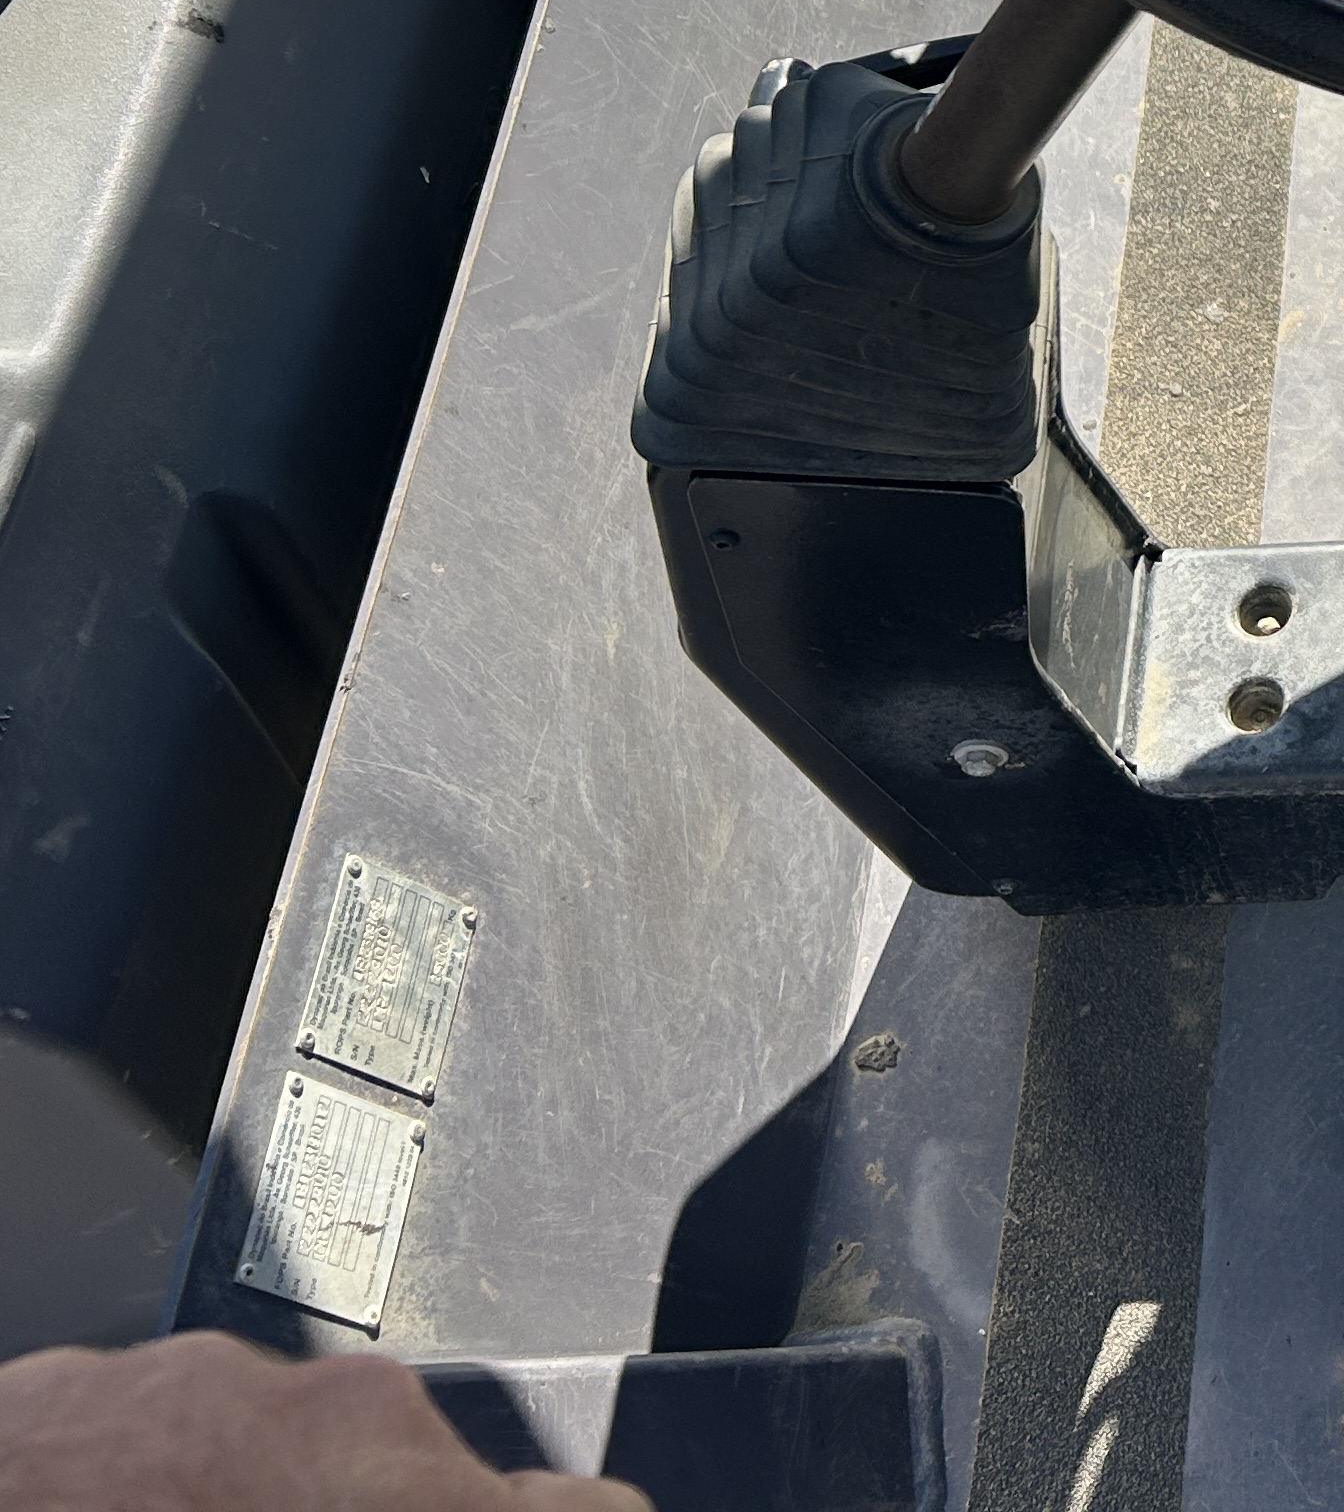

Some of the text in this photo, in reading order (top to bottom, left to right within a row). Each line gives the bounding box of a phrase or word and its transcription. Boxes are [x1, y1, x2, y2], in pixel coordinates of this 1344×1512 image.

[364, 1044, 377, 1068] Type
[281, 1238, 293, 1260] Part
[306, 1276, 319, 1301] Type
